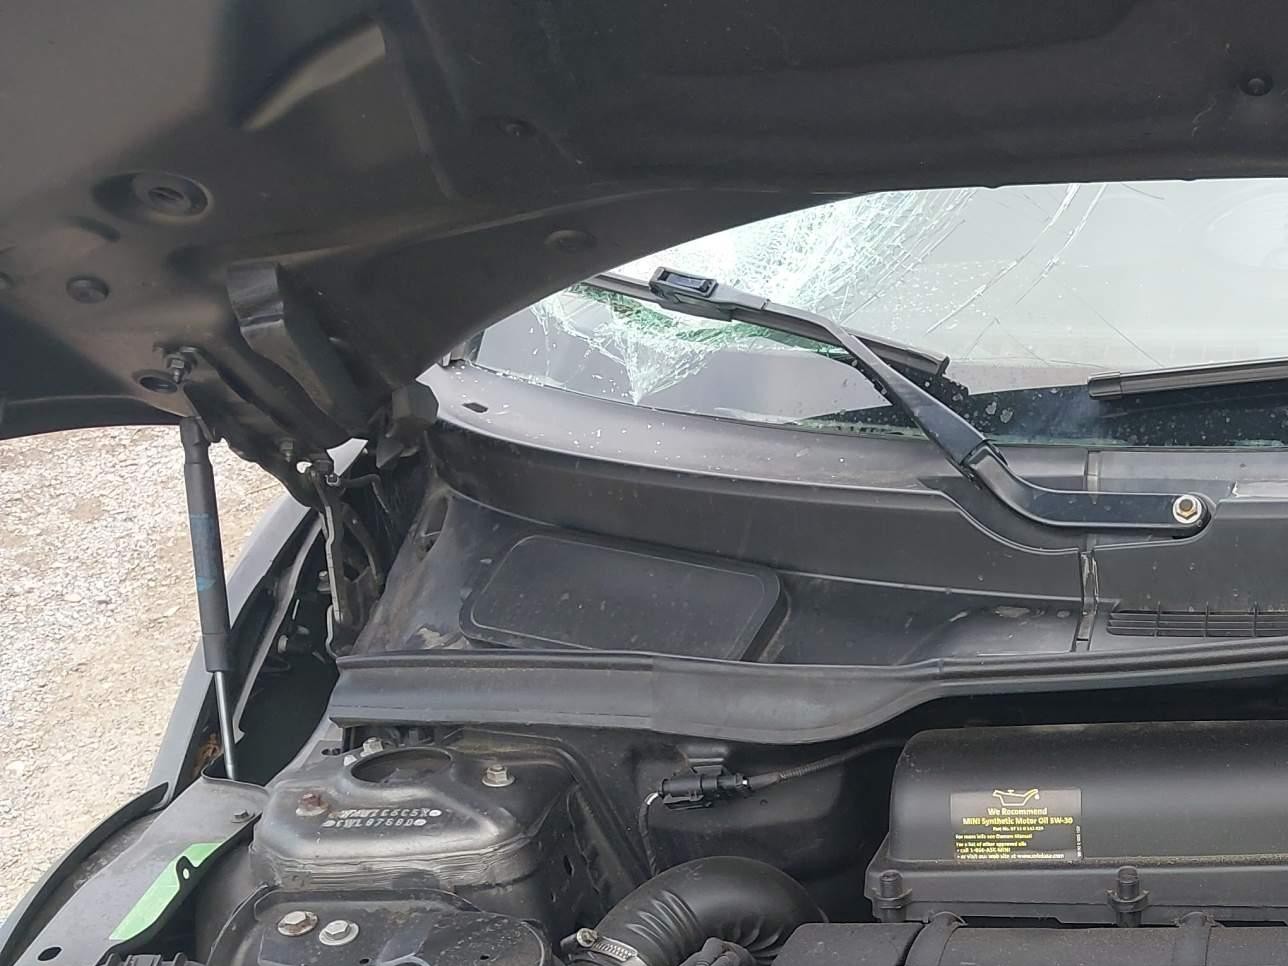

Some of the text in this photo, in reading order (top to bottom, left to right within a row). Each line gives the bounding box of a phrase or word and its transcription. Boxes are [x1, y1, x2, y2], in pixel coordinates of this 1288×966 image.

[987, 807, 1048, 816] We Recommend
[962, 816, 1074, 827] MINI Synthetic Motor Oil 5W-30
